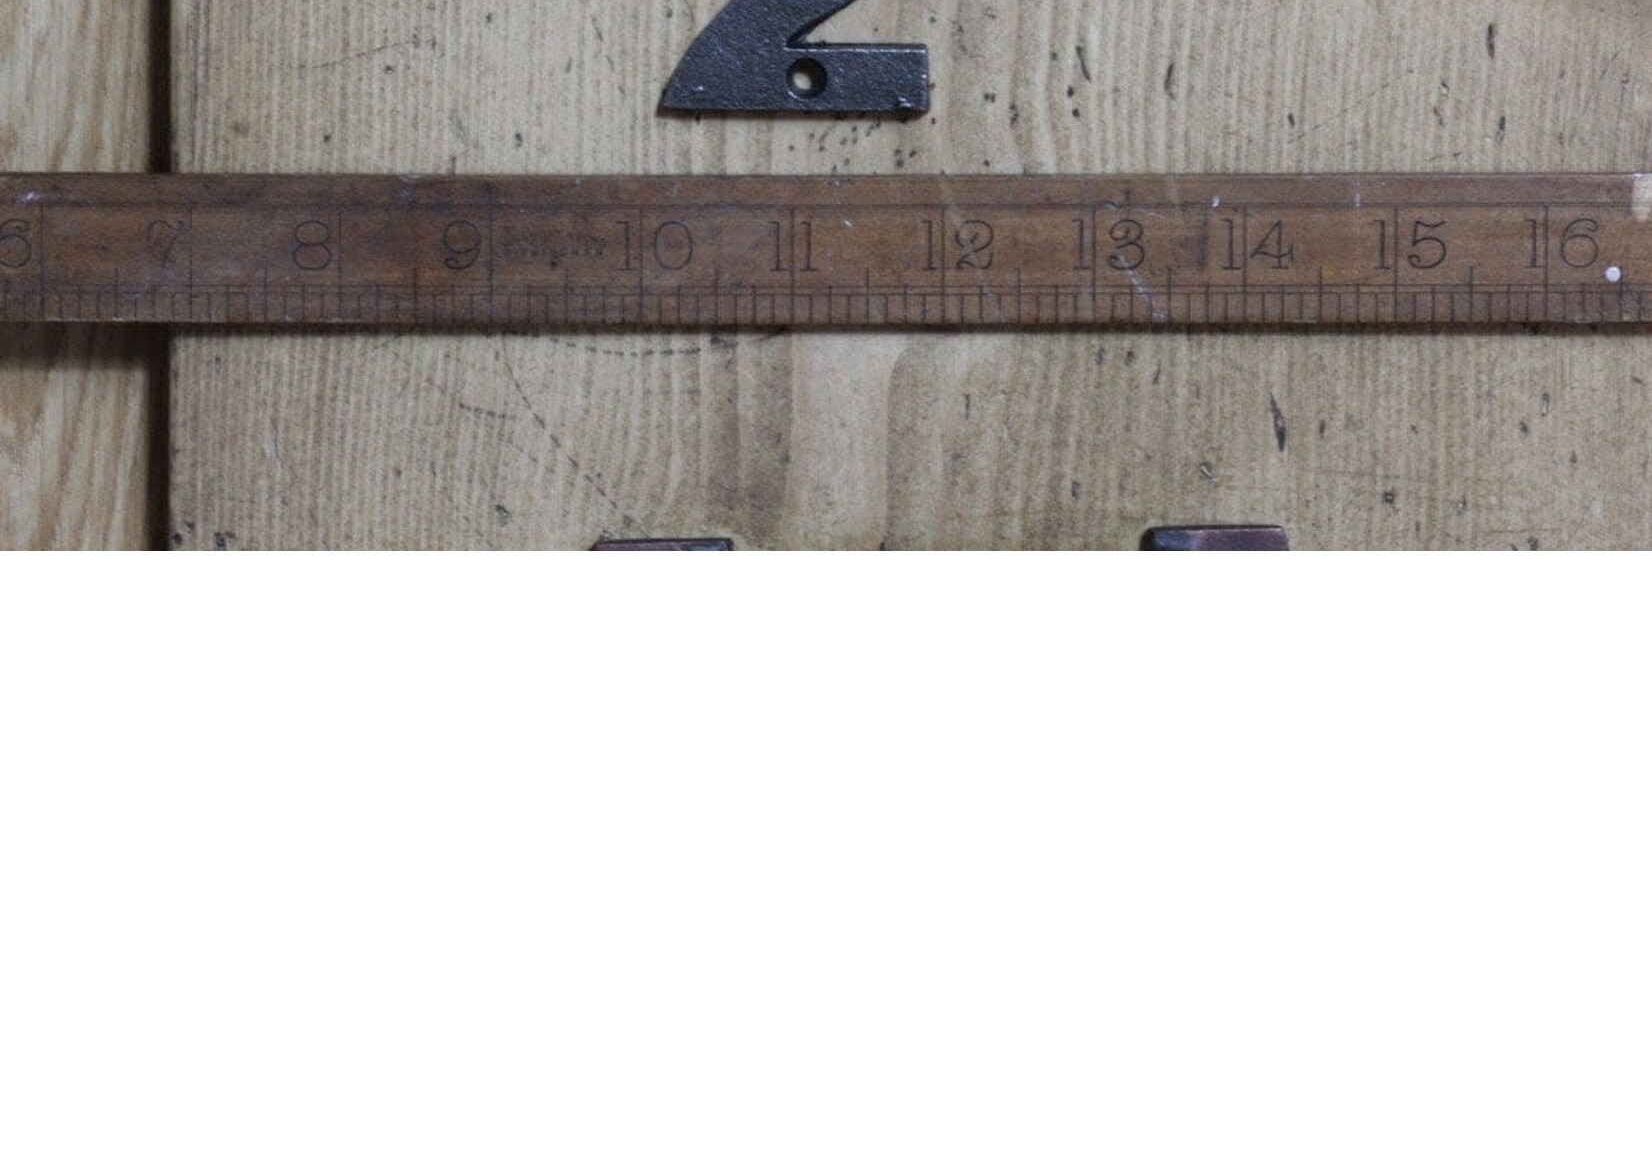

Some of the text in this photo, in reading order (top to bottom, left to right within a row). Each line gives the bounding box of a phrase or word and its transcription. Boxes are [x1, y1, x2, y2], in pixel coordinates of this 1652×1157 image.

[0, 218, 1598, 271] 6 7 8 9 10 11 12 13 14 15 16
